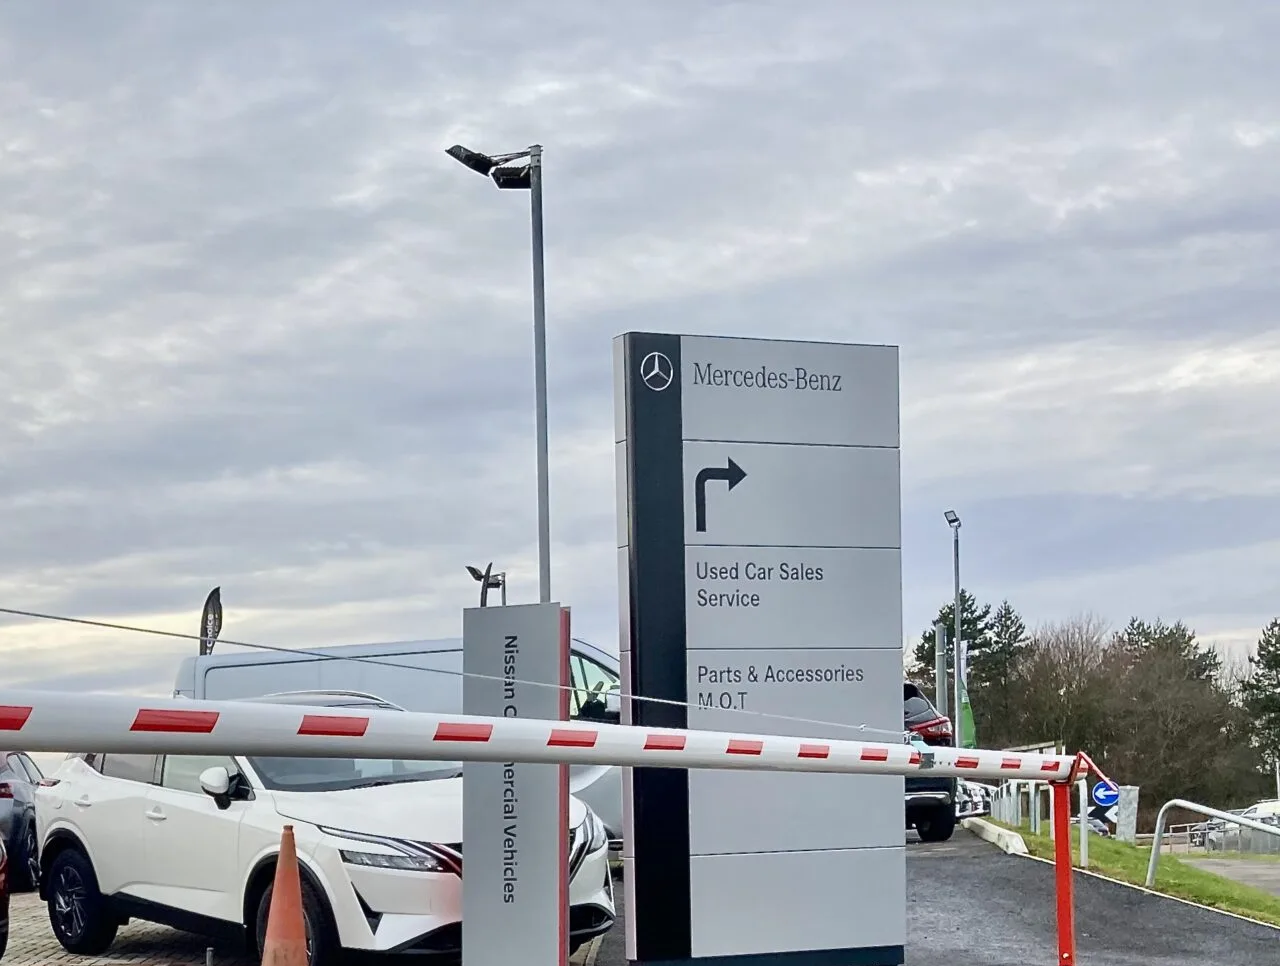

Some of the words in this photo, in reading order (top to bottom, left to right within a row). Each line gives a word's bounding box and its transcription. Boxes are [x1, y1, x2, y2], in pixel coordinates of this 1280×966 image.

[693, 362, 842, 392] Mercedes-Benz
[696, 561, 739, 580] Used
[744, 561, 774, 581] Car
[779, 562, 824, 581] Sales
[697, 588, 760, 607] Service
[504, 635, 519, 700] Nissan
[697, 665, 742, 684] Parts
[747, 665, 759, 683] &
[764, 664, 864, 683] Accessories
[503, 704, 518, 820] Cercial
[503, 824, 518, 904] Vehicles
